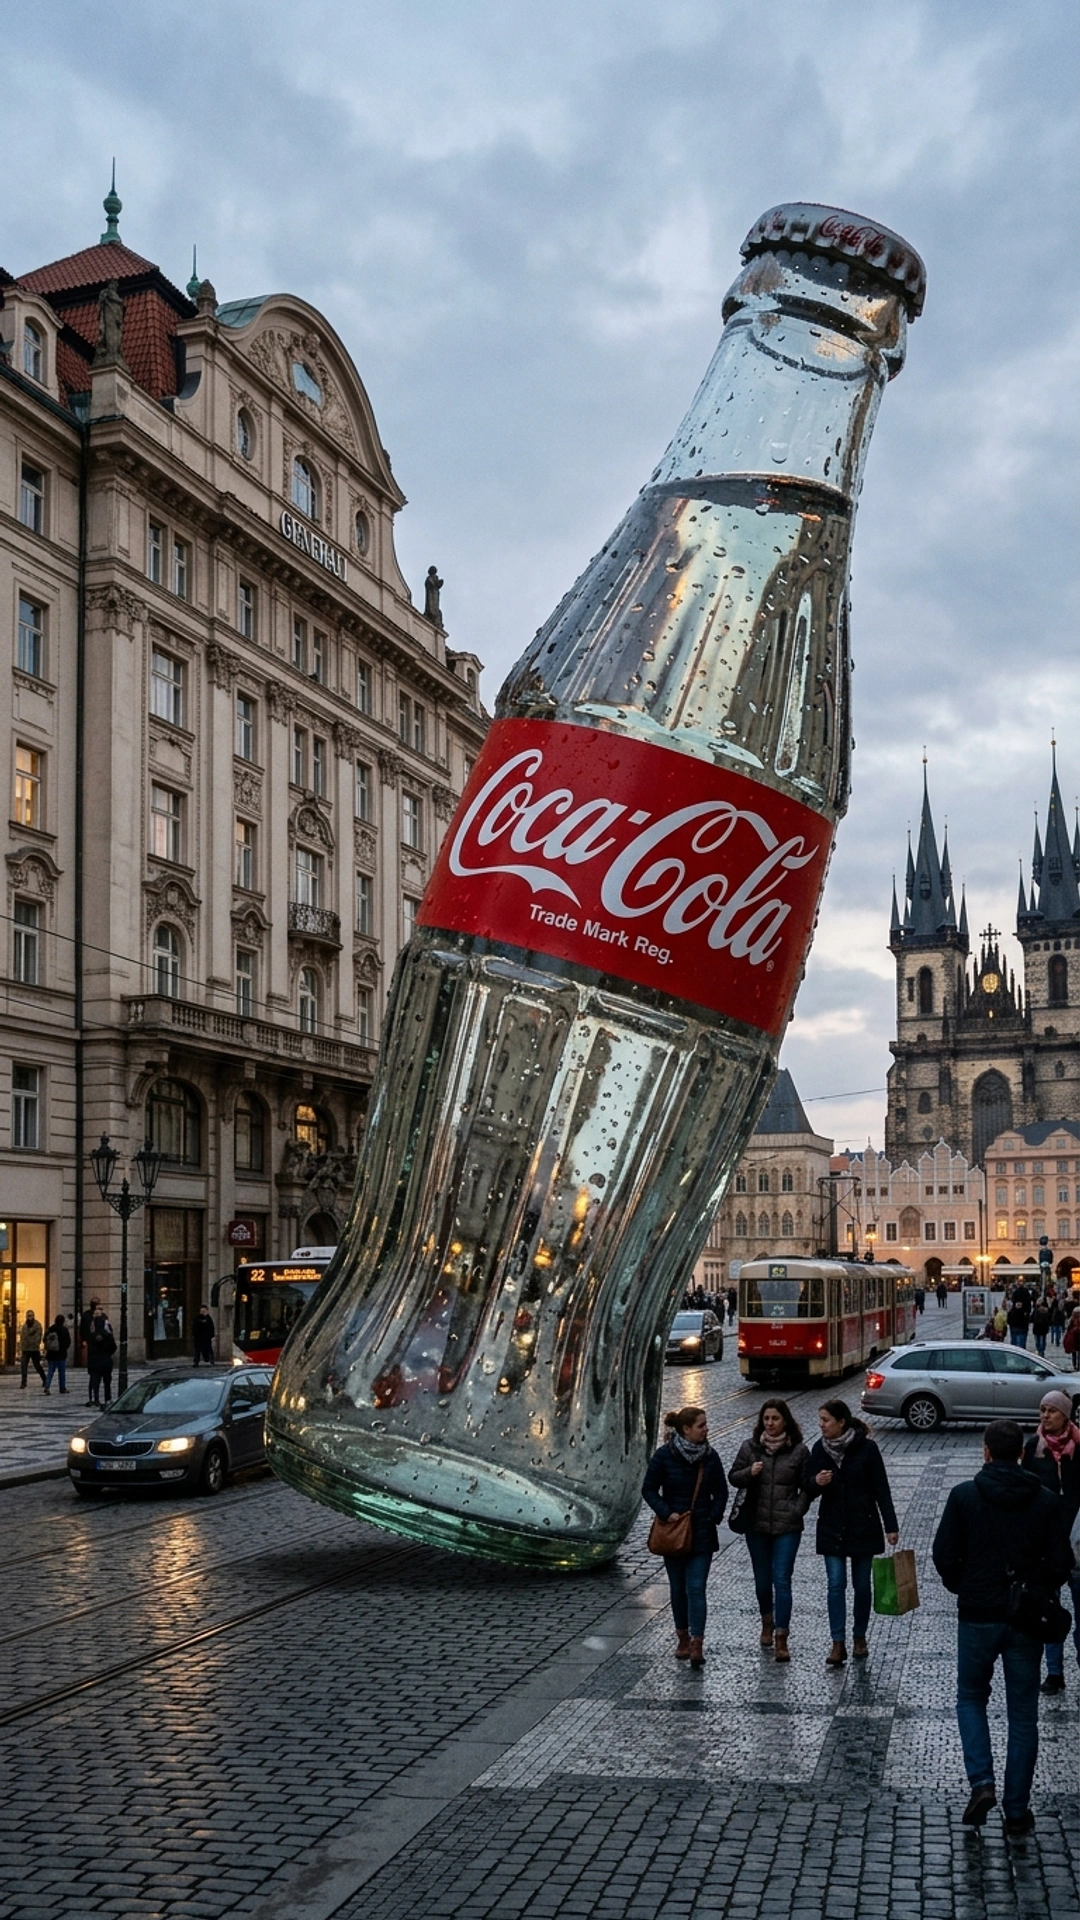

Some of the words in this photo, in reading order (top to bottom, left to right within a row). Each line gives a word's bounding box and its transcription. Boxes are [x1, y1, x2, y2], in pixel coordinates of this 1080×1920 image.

[449, 748, 819, 966] Coca-Cola
[530, 904, 578, 931] Trade
[583, 919, 630, 948] Mark
[634, 936, 674, 965] Reg.
[250, 1269, 265, 1281] 22
